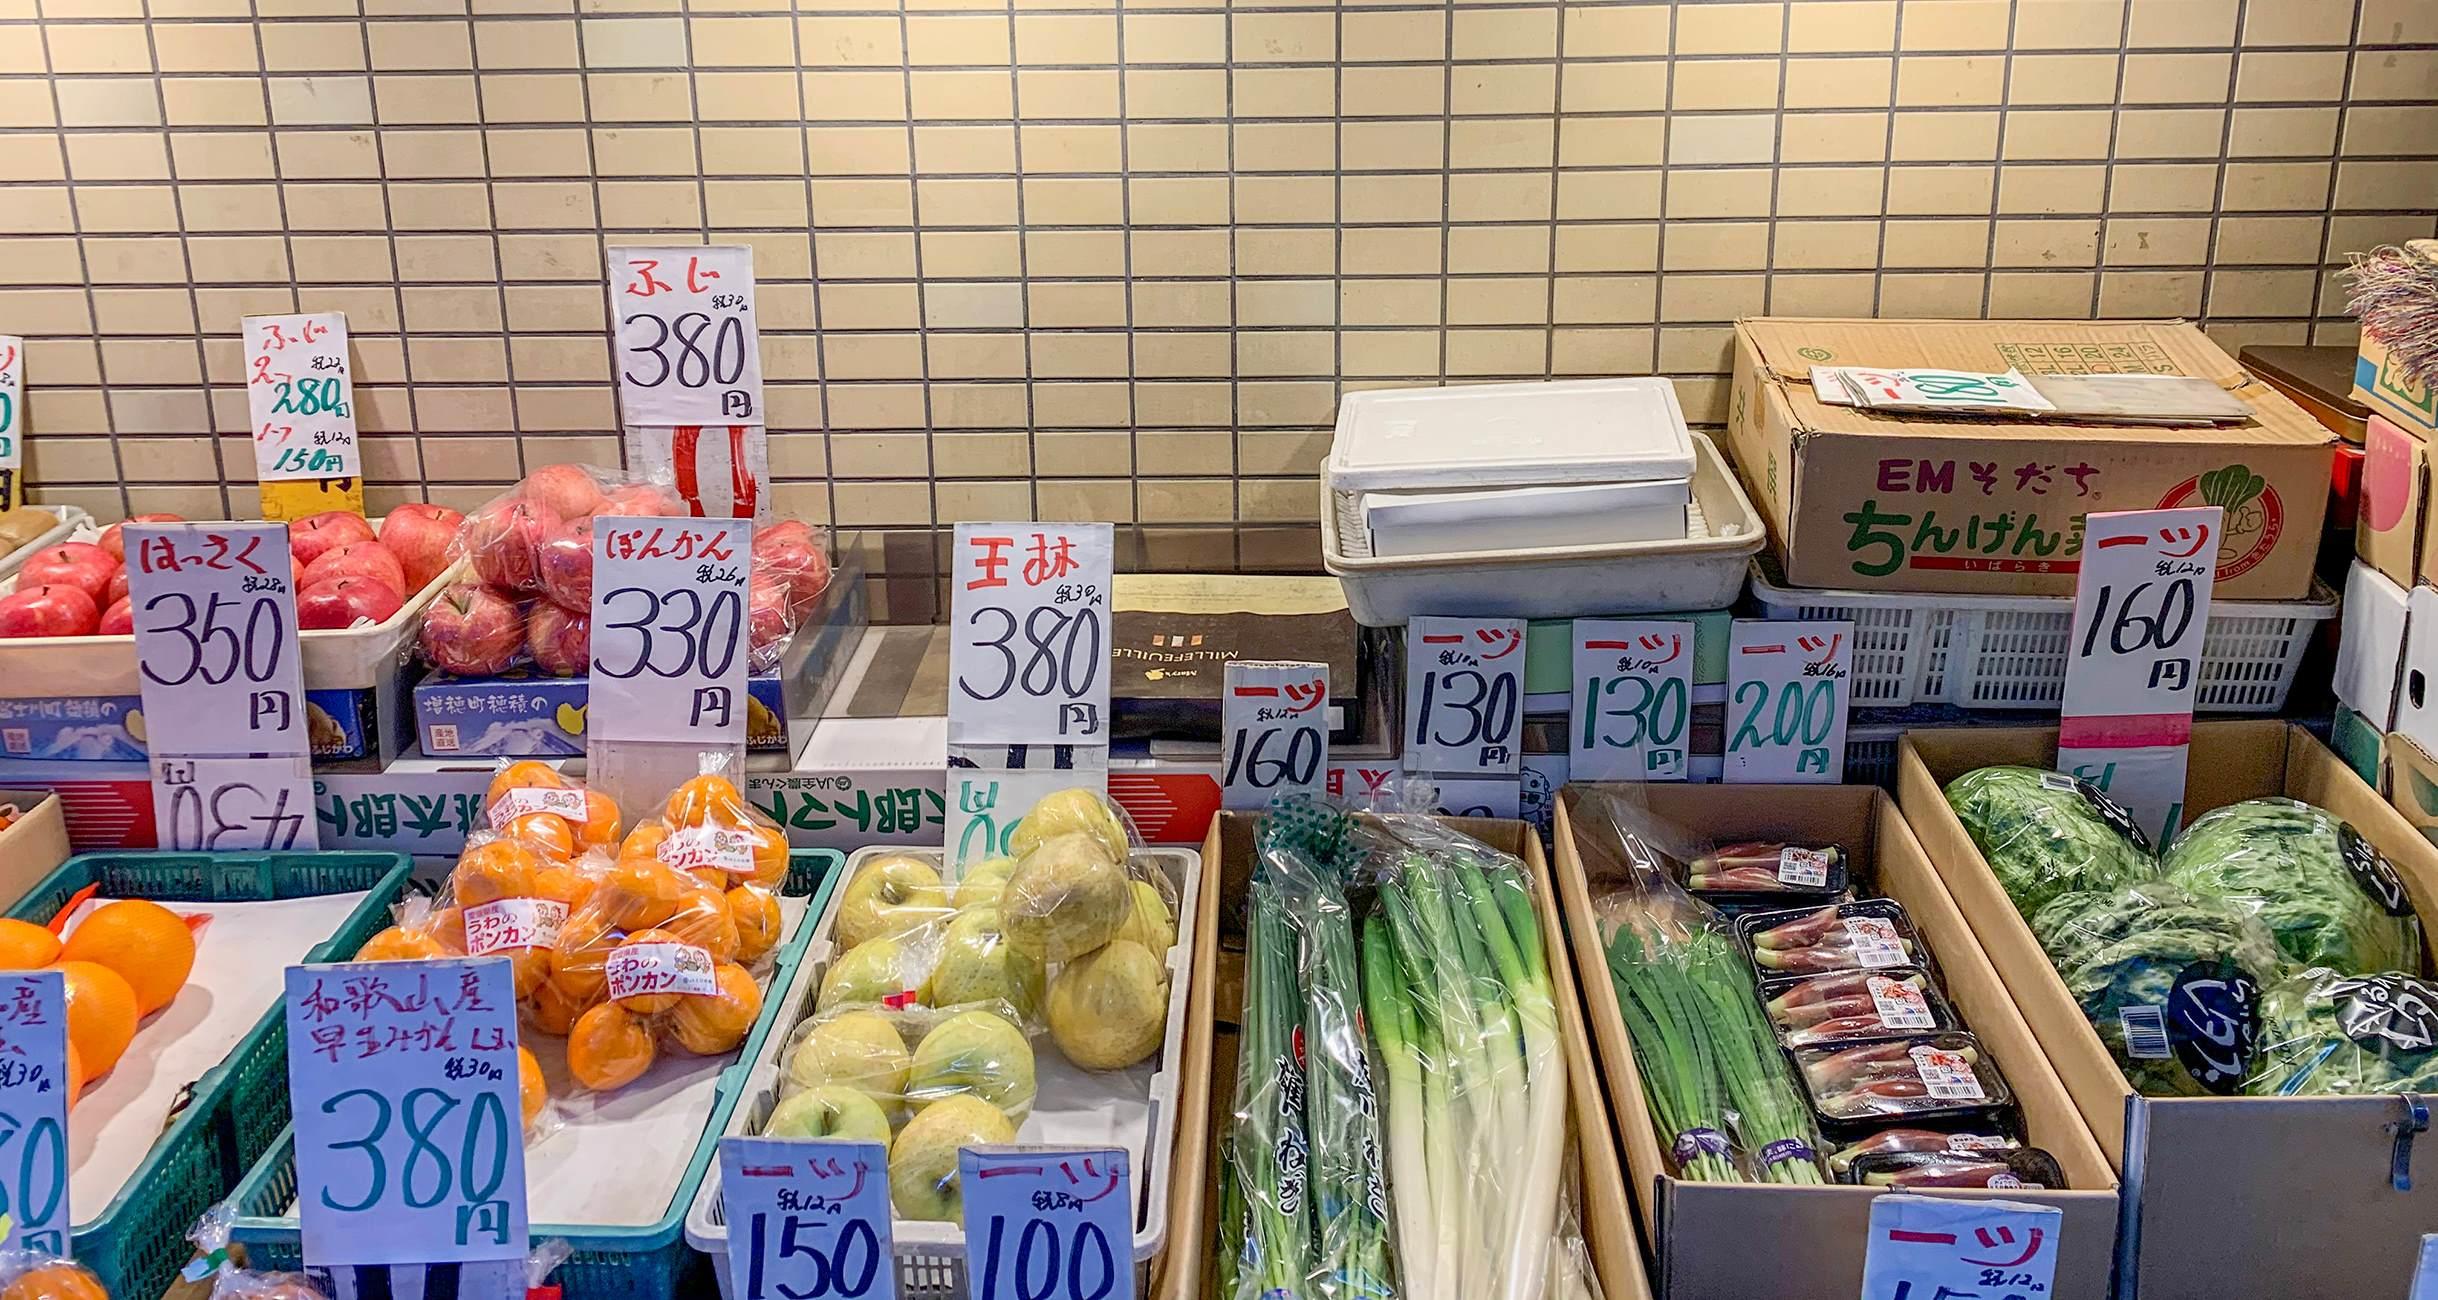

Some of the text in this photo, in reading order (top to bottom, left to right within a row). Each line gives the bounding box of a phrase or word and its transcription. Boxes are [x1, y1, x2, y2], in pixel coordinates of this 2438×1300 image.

[626, 257, 720, 296] ふじ
[263, 320, 328, 350] ふじ
[626, 313, 745, 387] 380
[722, 391, 752, 417] 円
[140, 535, 268, 574] はっさく
[606, 528, 733, 560] ぽんかん
[966, 534, 1078, 590] 王林
[594, 588, 741, 680] 330
[2082, 579, 2194, 657] 160
[140, 592, 283, 685] 350
[959, 606, 1099, 700] 380
[1112, 648, 1239, 663] MILLEFEUILLE
[2148, 659, 2190, 691] 円
[250, 692, 290, 731] 円
[690, 688, 732, 727] 円
[1059, 703, 1098, 736] 円
[1417, 671, 1516, 747] 130
[1583, 676, 1687, 749] 130
[1728, 680, 1834, 752] 200
[162, 761, 195, 785] 円
[1224, 727, 1321, 788] 160
[1479, 746, 1511, 766] 円
[1647, 749, 1682, 774] 円
[1797, 748, 1830, 773] 円
[748, 777, 835, 791] JA全農ぐんま
[960, 780, 999, 813] 円
[468, 913, 518, 935] うわの
[471, 925, 537, 952] ポンカン
[608, 956, 658, 976] うわの
[611, 972, 677, 995] ポンカン
[301, 967, 495, 1022] 和歌山産
[311, 1018, 456, 1063] 早生みかん
[321, 1087, 509, 1212] 380
[455, 1200, 511, 1247] 円
[747, 1213, 880, 1300] 150
[982, 1215, 1115, 1300] 100
[1890, 1226, 2043, 1267] 一ツ
